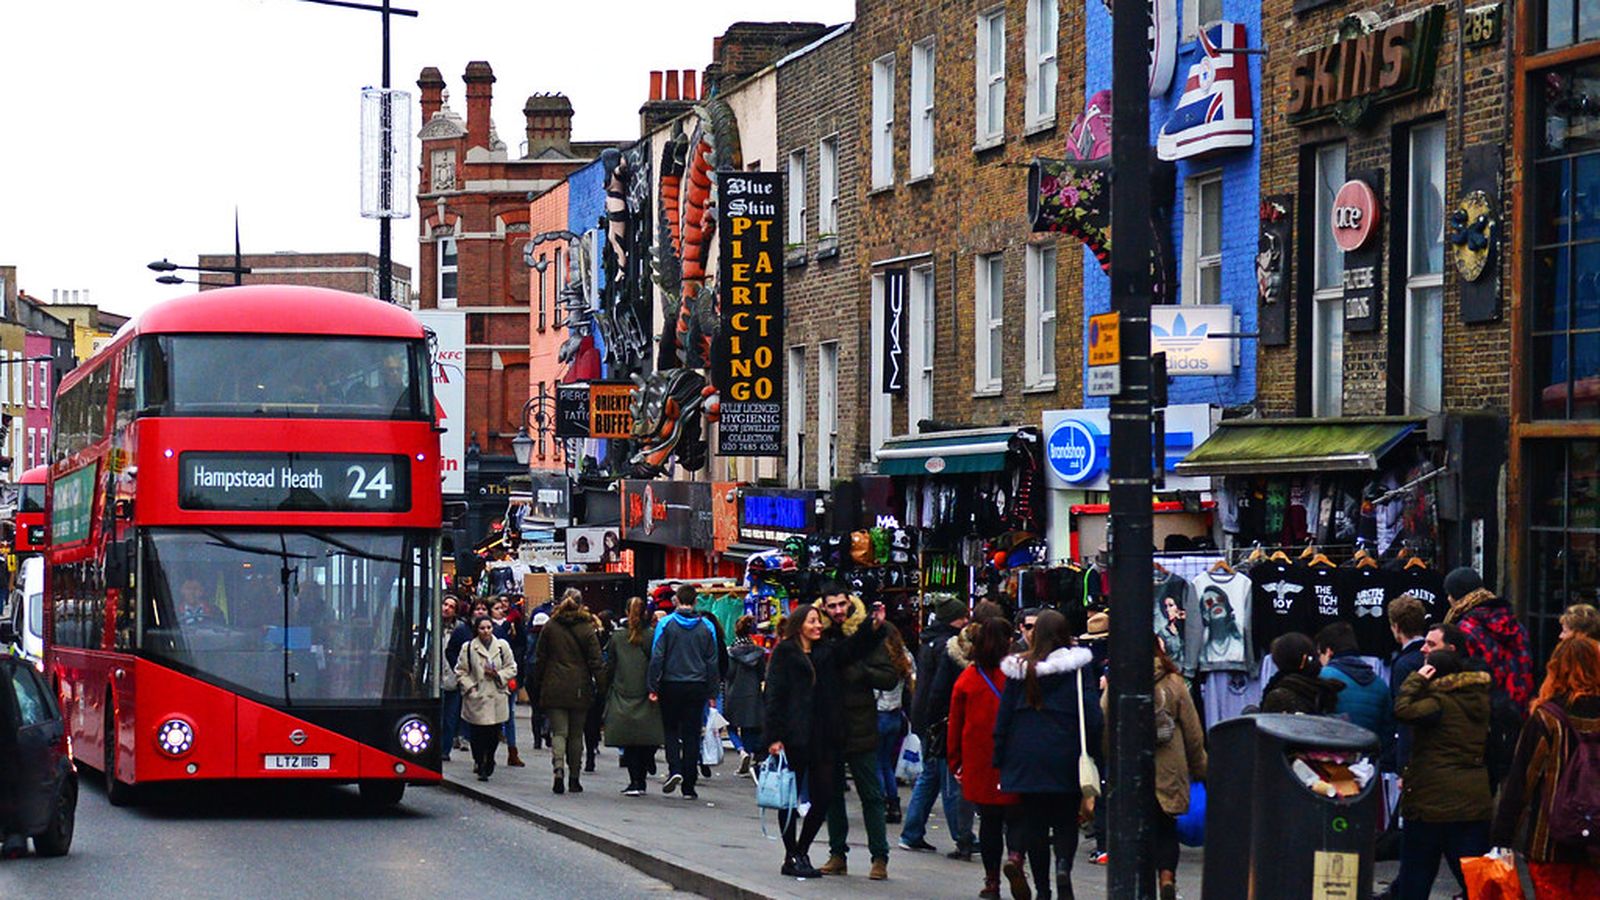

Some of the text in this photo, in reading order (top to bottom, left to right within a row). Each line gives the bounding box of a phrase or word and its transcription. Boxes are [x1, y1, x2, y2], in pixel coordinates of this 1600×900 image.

[1463, 13, 1493, 43] 285
[1287, 21, 1409, 112] SKINS
[727, 178, 773, 195] Blue
[727, 199, 775, 217] Skin
[1336, 206, 1363, 229] ace
[731, 217, 752, 401] PIERCING
[755, 220, 773, 400] TATTOO
[438, 351, 463, 360] KFC
[720, 403, 741, 413] FULLY
[721, 413, 780, 424] HYGIENIC
[720, 424, 739, 432] BODY
[728, 433, 774, 442] COLLECTION
[194, 465, 323, 492] Hampstead Heath
[346, 465, 393, 500] 24
[1315, 585, 1333, 595] THE
[276, 756, 299, 768] LTZ
